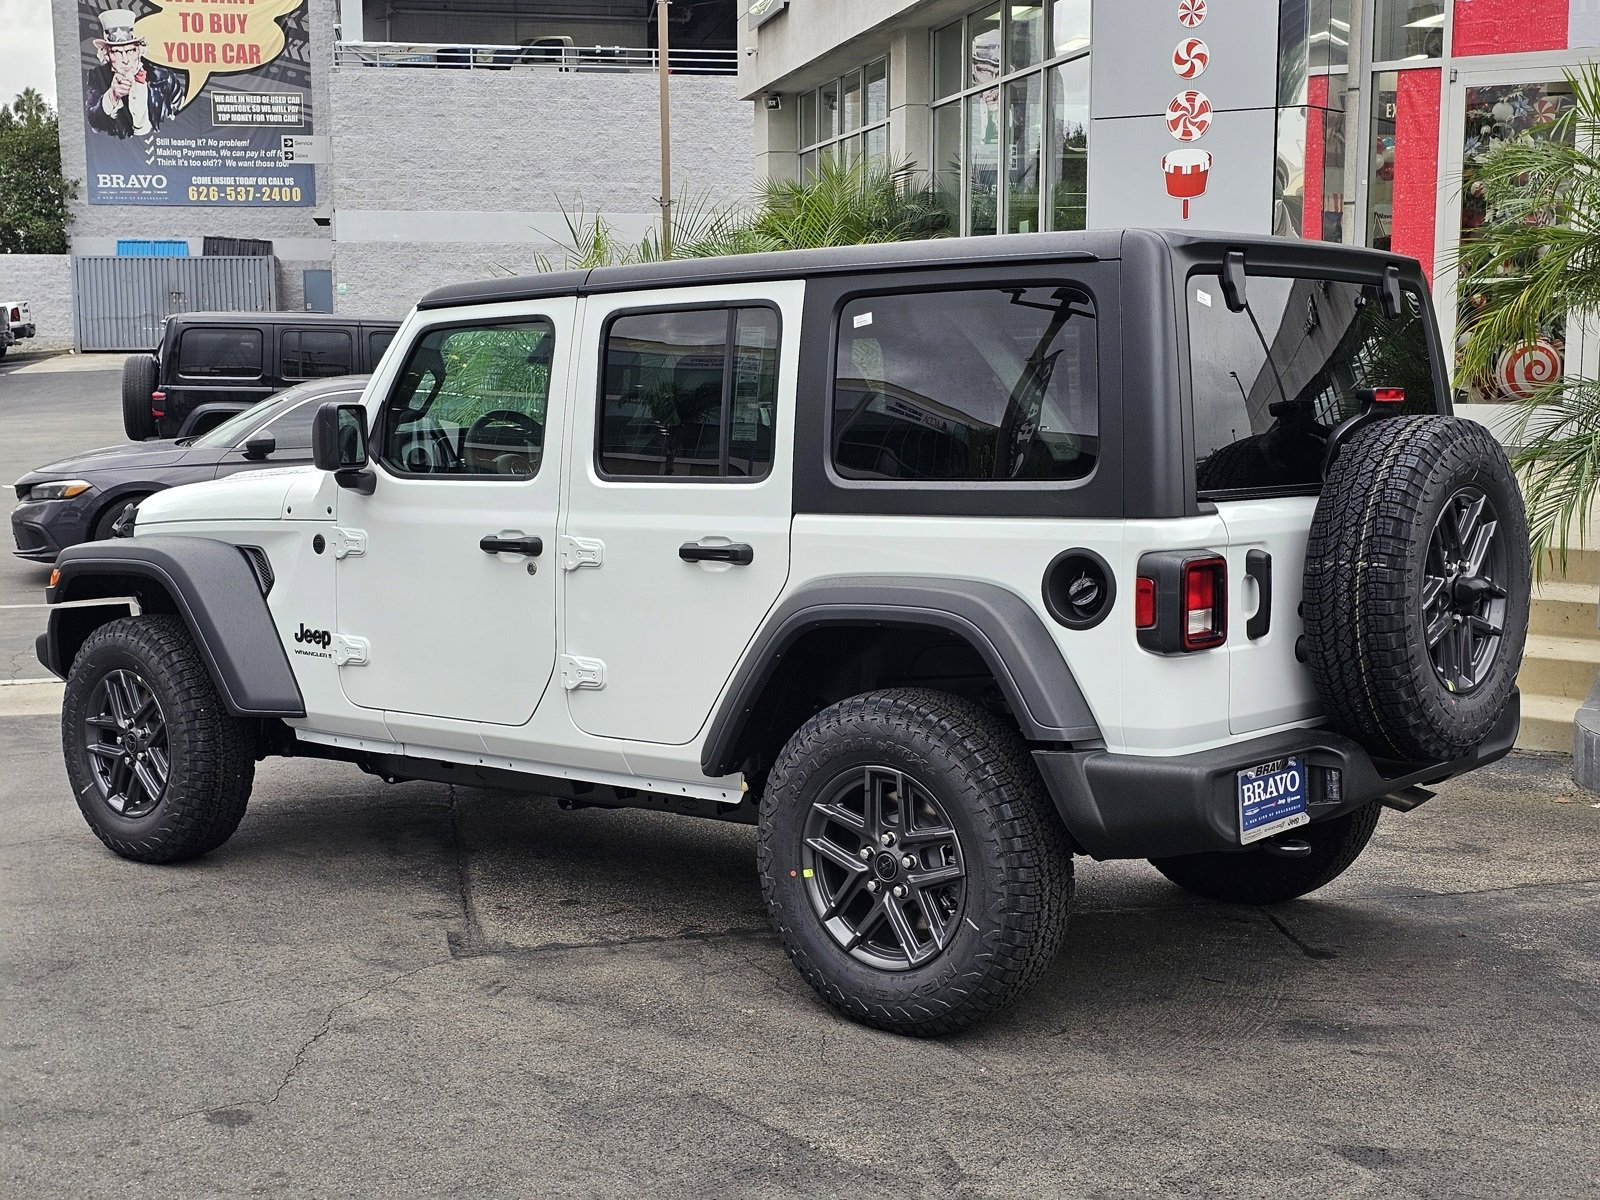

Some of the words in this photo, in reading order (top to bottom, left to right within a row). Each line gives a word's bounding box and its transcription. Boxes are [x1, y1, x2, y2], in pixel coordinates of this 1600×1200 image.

[179, 12, 204, 34] TO
[209, 13, 248, 34] BUY
[163, 42, 217, 64] YOUR
[221, 43, 261, 65] CAR
[214, 95, 225, 103] WE
[225, 95, 237, 103] ARE
[238, 95, 245, 103] IN
[246, 95, 261, 103] NEED
[270, 96, 287, 104] USED
[287, 96, 300, 104] CAR
[252, 104, 260, 113] SO
[261, 105, 272, 113] WE
[272, 105, 287, 113] WILL
[287, 105, 299, 113] PAY
[218, 113, 230, 121] TOP
[231, 113, 252, 122] MONEY
[253, 114, 265, 122] FOR
[265, 114, 282, 122] YOUR
[283, 114, 298, 122] CAR!
[156, 137, 170, 146] Still
[171, 138, 196, 147] leasing
[197, 138, 206, 146] it?
[218, 139, 250, 147] problem!
[156, 148, 181, 157] Making
[182, 148, 218, 158] Payments,
[220, 149, 231, 157] We
[246, 150, 259, 158] pay
[260, 149, 265, 157] it
[266, 149, 276, 157] off
[157, 158, 177, 166] Think
[226, 159, 237, 167] We
[97, 174, 168, 189] BRAVO
[191, 176, 212, 185] COME
[212, 176, 235, 185] INSIDE
[236, 176, 257, 185] TODAY
[258, 177, 267, 185] OR
[268, 177, 284, 185] CALL
[284, 177, 295, 186] US
[188, 186, 301, 202] 626-537-2400
[294, 623, 332, 649] Jeep
[294, 649, 328, 659] WRANGLER
[1243, 771, 1300, 806] BRAVO
